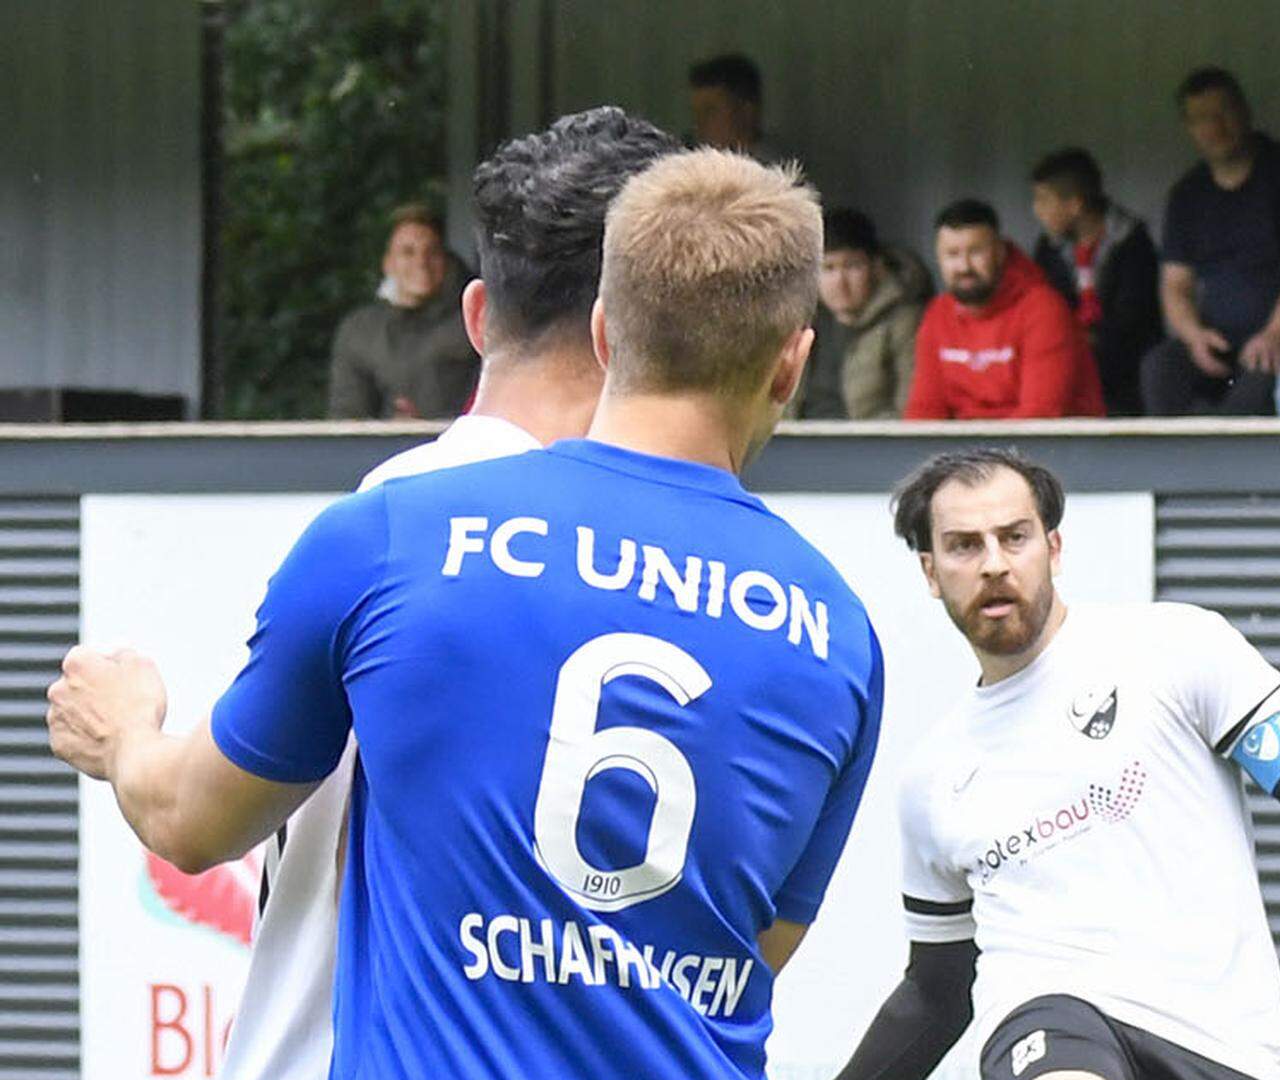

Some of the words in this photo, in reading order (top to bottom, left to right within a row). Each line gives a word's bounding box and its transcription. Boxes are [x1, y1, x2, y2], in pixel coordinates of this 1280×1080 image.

[441, 516, 549, 578] FC
[575, 525, 830, 661] UNION
[533, 631, 714, 913] 6
[582, 874, 622, 896] 1910
[150, 983, 234, 1077] Bl
